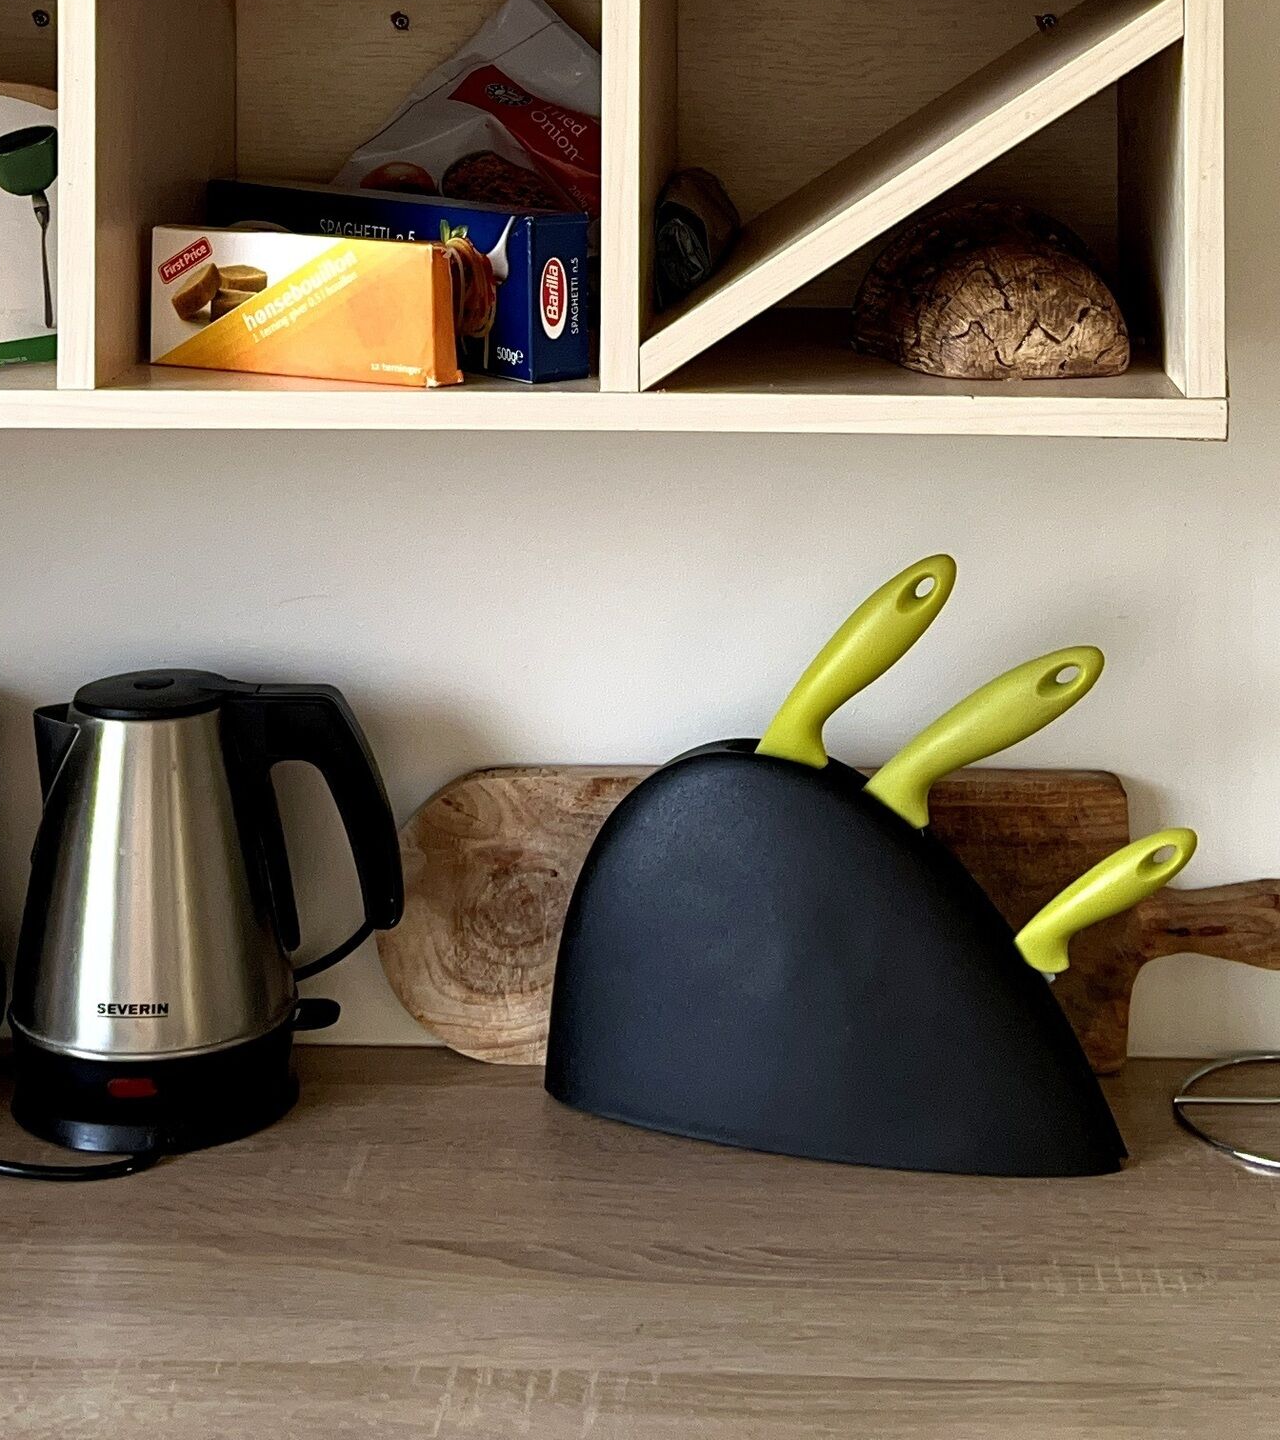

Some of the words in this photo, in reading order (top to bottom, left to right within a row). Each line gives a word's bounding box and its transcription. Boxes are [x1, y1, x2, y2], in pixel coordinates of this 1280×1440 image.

[162, 255, 186, 279] First
[182, 243, 208, 266] Price
[545, 264, 559, 321] Barilla
[570, 277, 579, 335] SPAGHETTI
[97, 1003, 169, 1016] SEVERIN
